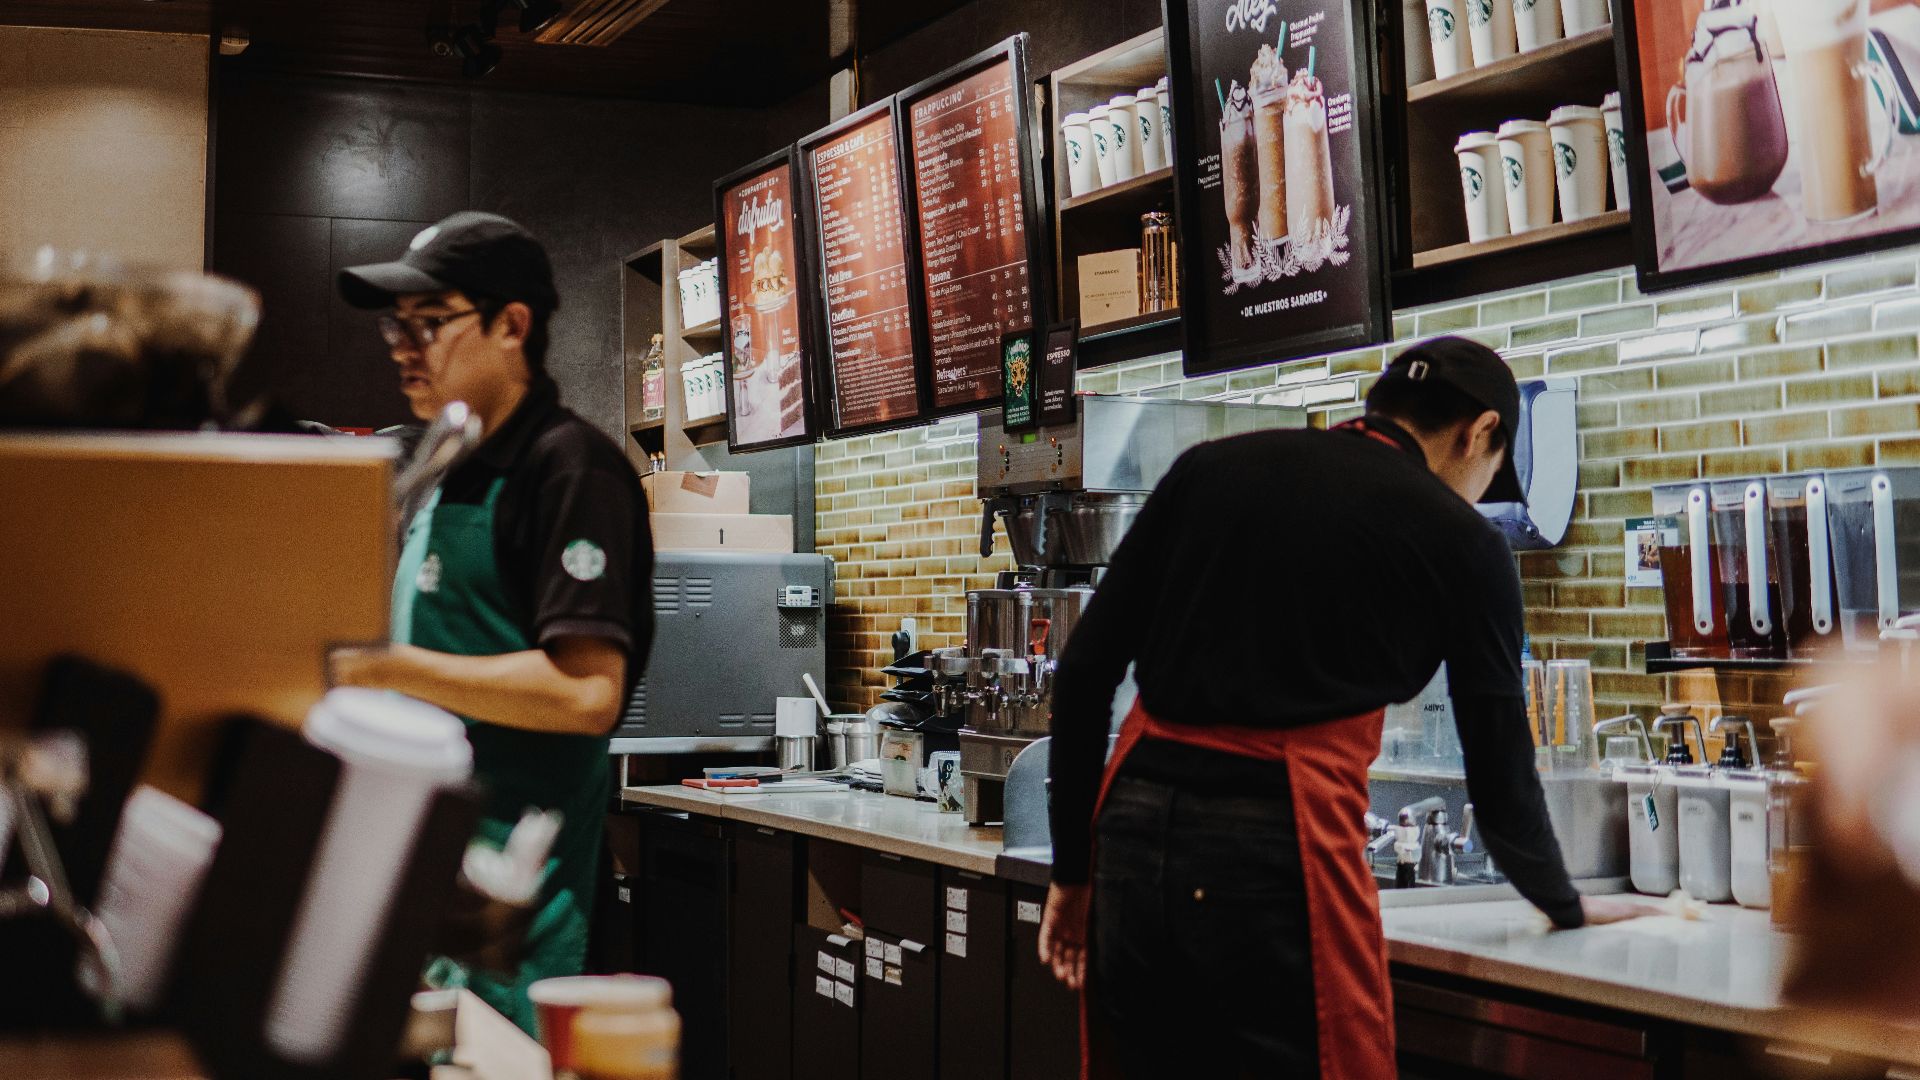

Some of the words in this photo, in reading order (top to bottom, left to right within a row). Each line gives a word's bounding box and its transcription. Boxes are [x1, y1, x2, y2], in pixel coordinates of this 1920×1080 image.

[915, 91, 962, 119] FRAPPUCCINO
[817, 144, 845, 164] ESPRESSO
[738, 190, 784, 245] disfrutar
[1245, 306, 1253, 317] DE
[1254, 298, 1289, 315] NUESTROS
[1290, 290, 1324, 308] SABORES
[1047, 349, 1070, 360] ESPRESSO
